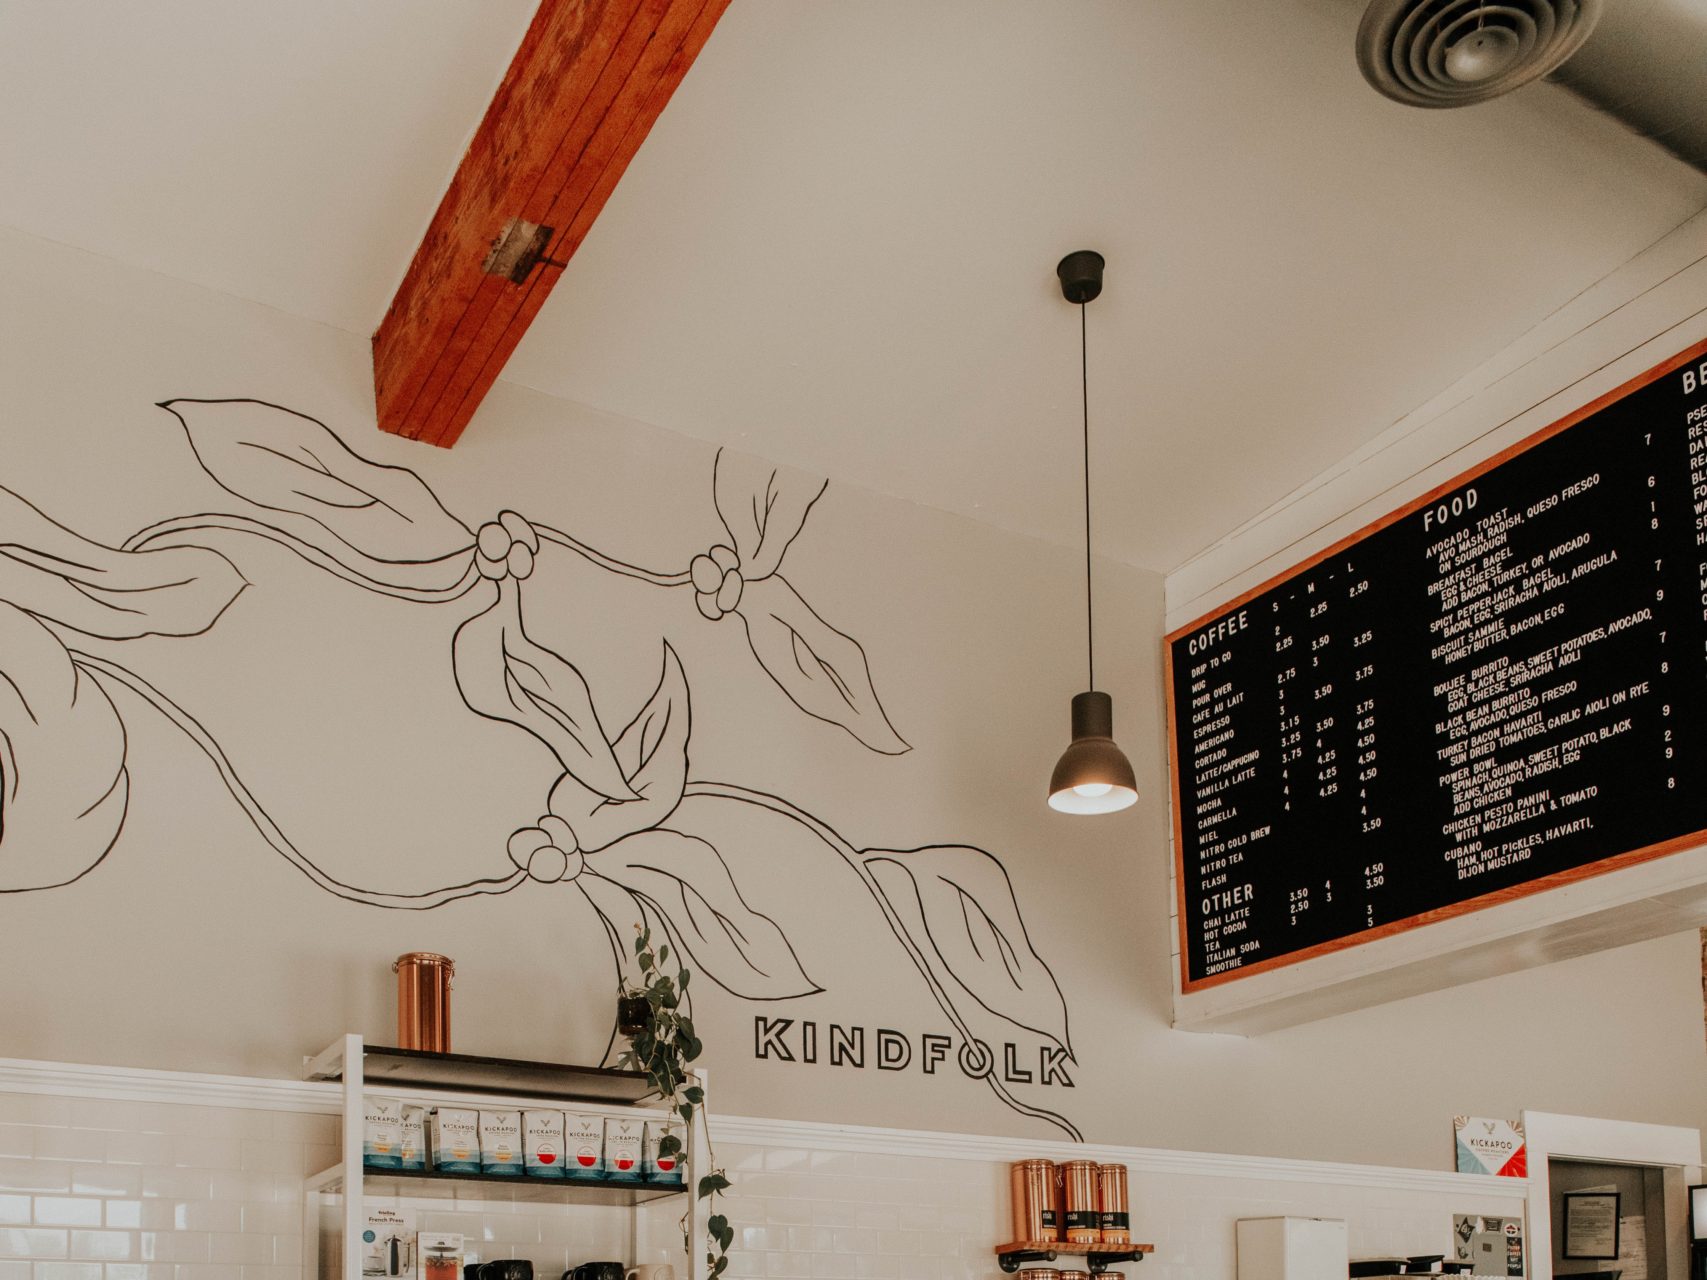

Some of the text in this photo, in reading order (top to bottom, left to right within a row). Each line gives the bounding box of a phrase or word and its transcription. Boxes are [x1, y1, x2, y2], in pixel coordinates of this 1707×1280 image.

[1424, 488, 1477, 532] FOOD
[1439, 547, 1455, 563] AVO
[1527, 494, 1558, 518] QUESO
[1562, 473, 1599, 501] FRESCO
[1426, 507, 1507, 558] AVOCADO TOAST
[1439, 532, 1507, 574] ON SOURDOUGH
[1272, 563, 1354, 612] S M L
[1427, 547, 1513, 596] BREAKFAST BAGEL
[1441, 562, 1502, 600] EGG & CHEESE
[1442, 595, 1458, 612] ADD
[1531, 555, 1544, 568] OR
[1548, 532, 1590, 561] AVOCADO
[1494, 586, 1539, 614] SRIRACHA
[1571, 550, 1617, 580] ARUGULA
[1430, 568, 1554, 632] SPICY PEPPERJACK BAGEL
[1189, 610, 1248, 655] COFFEE
[1431, 618, 1504, 659] BISCUIT SAMMIE
[1445, 644, 1472, 664] HONEY
[1544, 603, 1564, 620] EGG
[1191, 651, 1231, 678] DRIP TO GO
[1433, 656, 1509, 696] BOUJEE BURRITO
[1448, 695, 1468, 712] GOAT
[1510, 661, 1553, 687] SRIRACHA
[1558, 649, 1580, 667] AIOLI
[1466, 673, 1495, 694] BLACK
[1527, 646, 1559, 668] SWEET
[1192, 679, 1206, 693] MUG
[1192, 682, 1232, 708] POUR OVER
[1509, 695, 1538, 715] QUESO
[1541, 680, 1577, 703] FRESCO
[1192, 692, 1243, 724] CAFE AU LAIT
[1435, 687, 1530, 734] BLACK BEAN BURRITO
[1450, 751, 1467, 766] SUN
[1469, 740, 1496, 759] DRIED
[1547, 708, 1581, 729] GARLIC
[1585, 697, 1609, 715] AIOLI
[1612, 690, 1626, 704] ON
[1630, 681, 1649, 698] RYE
[1193, 715, 1230, 739] ESPRESSO
[1194, 729, 1234, 754] AMERICANO
[1437, 711, 1542, 760] TURKEY BACON HAVARTI
[1528, 745, 1559, 765] SWEET
[1599, 718, 1631, 739] BLACK
[1195, 748, 1227, 768] CORTADO
[1196, 750, 1259, 784] LATTE/CAPPUCINO
[1439, 757, 1497, 787] POWER BOWL
[1563, 750, 1580, 765] EGG
[1196, 767, 1255, 798] VANILLA LATTE
[1197, 798, 1222, 814] MOCHA
[1442, 789, 1550, 835] CHICKEN PESTO PANINI
[1453, 786, 1512, 816] ADD CHICKEN
[1455, 785, 1597, 842] WITH MOZZARELLA & TOMATO
[1198, 807, 1237, 829] CARMELLA
[1199, 830, 1218, 844] MIEL
[1200, 825, 1270, 859] NITRO COLD BREW
[1444, 841, 1482, 861] CUBANO
[1480, 846, 1498, 861] HOT
[1200, 852, 1243, 875] NITRO TEA
[1458, 848, 1531, 880] DIJON MUSTARD
[1201, 874, 1226, 890] FLASH
[1202, 884, 1253, 914] OTHER
[1203, 907, 1250, 929] CHAI LATTE
[1204, 920, 1247, 941] HOT COCOA
[1205, 940, 1220, 952] TEA
[1206, 940, 1260, 963] ITALIAN SODA
[1206, 957, 1242, 975] SMOOTHIE
[754, 1015, 1076, 1088] KINDFOLK
[1470, 1138, 1513, 1150] KICKAPOO
